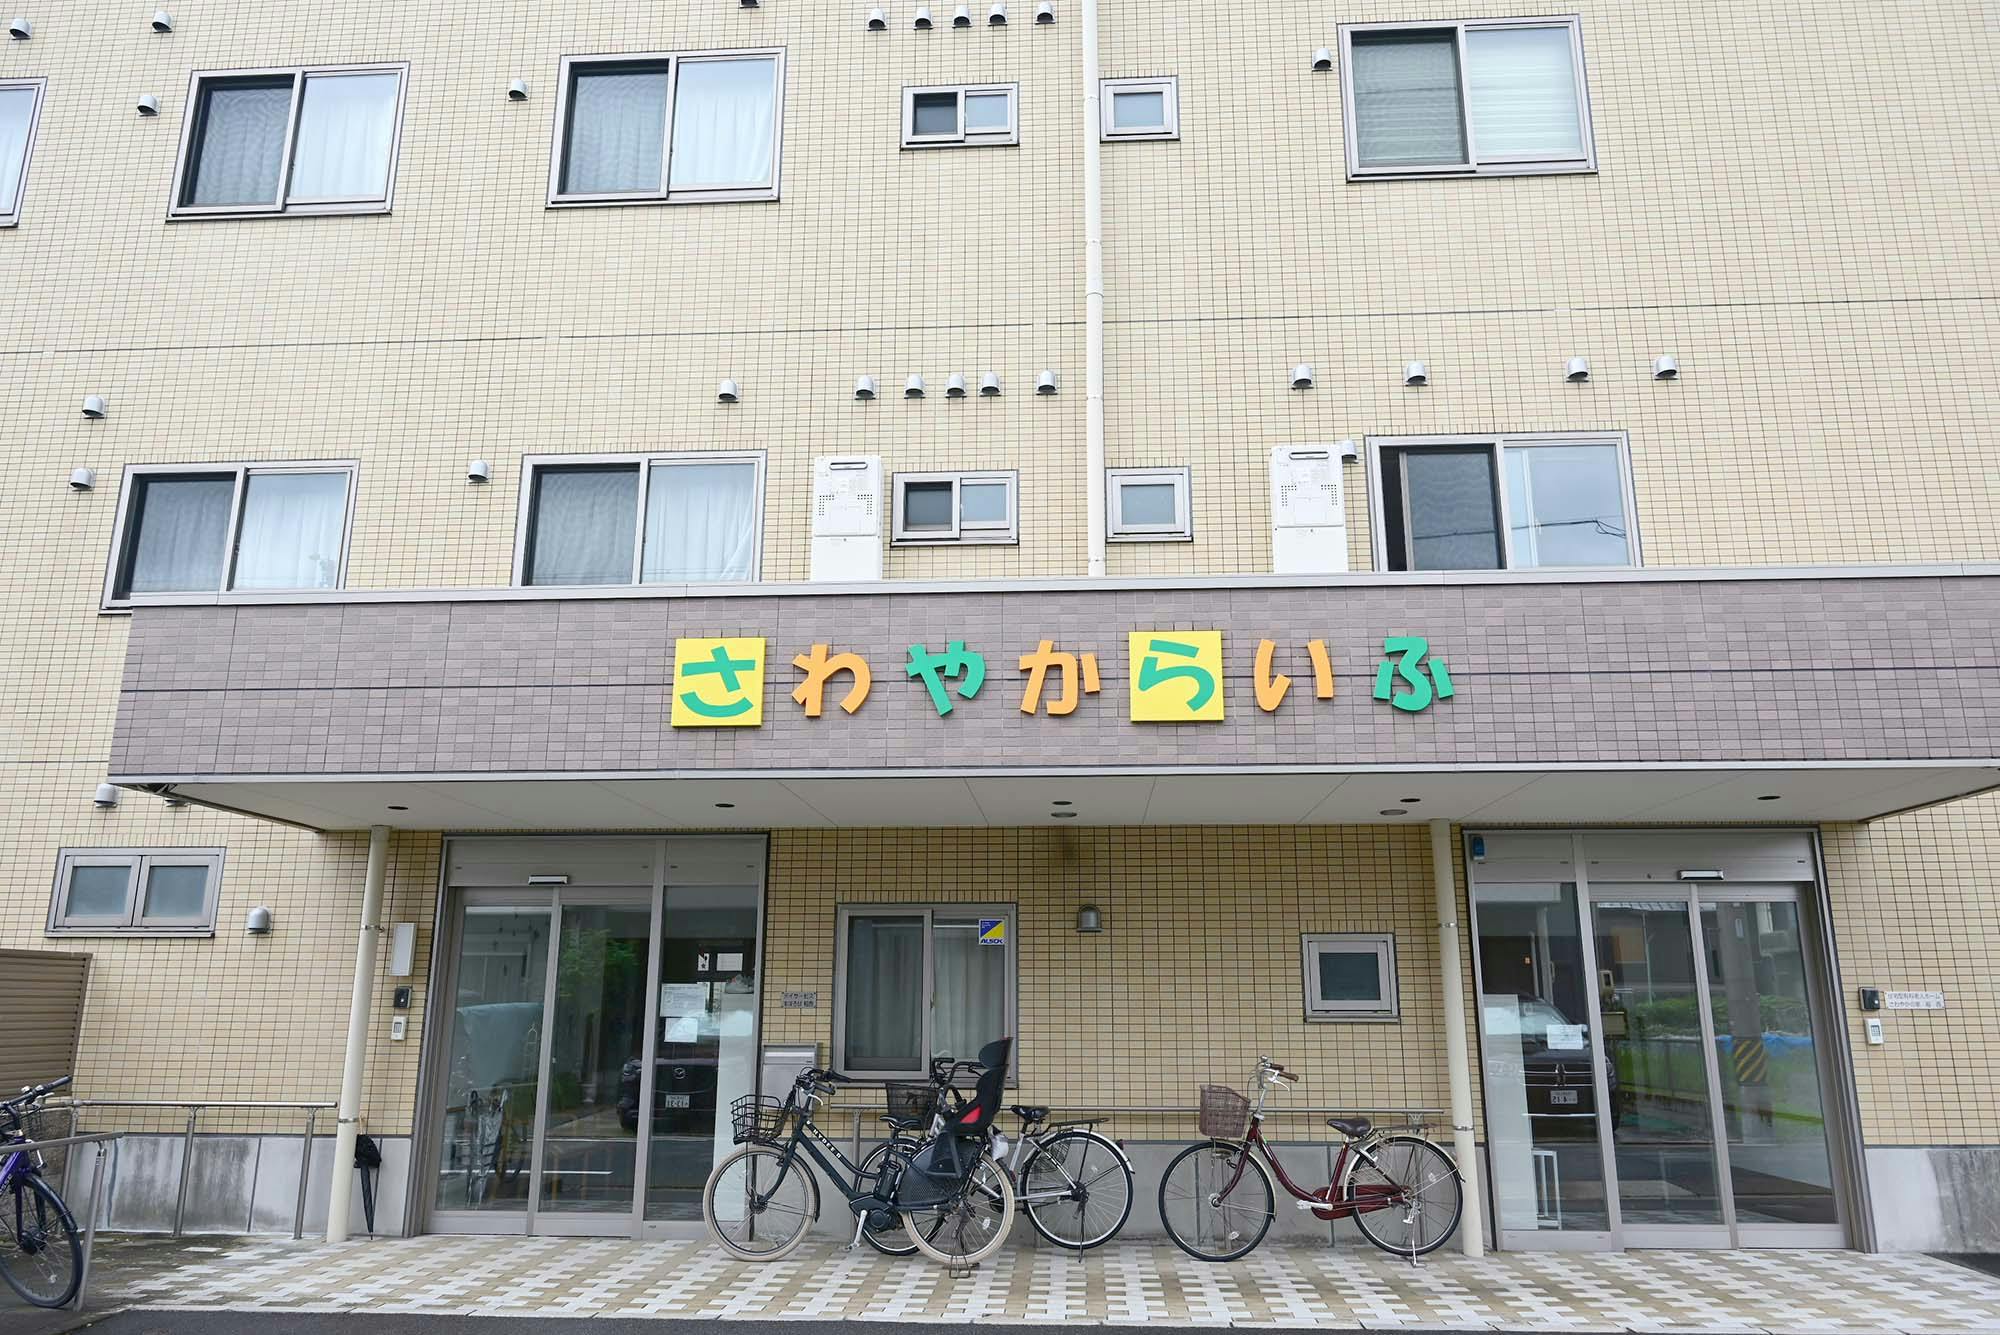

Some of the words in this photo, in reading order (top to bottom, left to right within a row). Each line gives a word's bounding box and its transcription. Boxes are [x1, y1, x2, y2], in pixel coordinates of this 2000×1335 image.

[681, 634, 1454, 718] さわやからいふ
